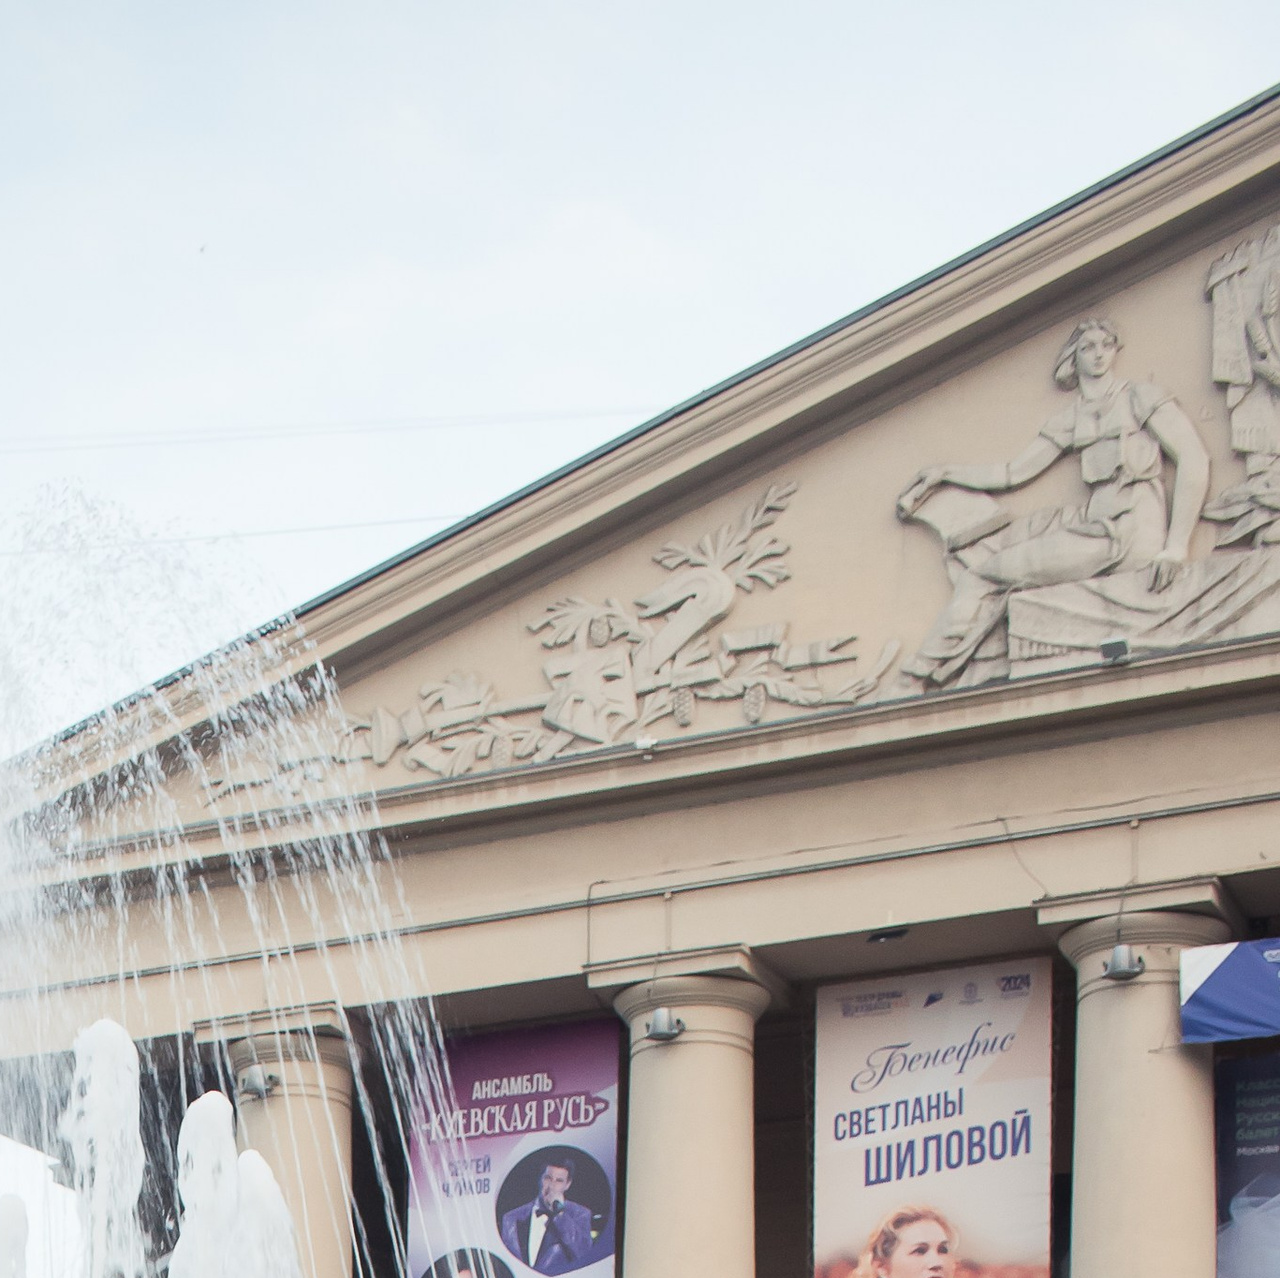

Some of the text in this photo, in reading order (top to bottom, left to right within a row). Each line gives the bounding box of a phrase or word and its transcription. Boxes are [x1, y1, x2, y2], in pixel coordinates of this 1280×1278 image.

[472, 1073, 553, 1100] АНСАМБЛЬ
[850, 1022, 1016, 1094] Бенефис
[834, 1087, 964, 1141] СВЕТЛАНЫ
[864, 1108, 1032, 1187] ШИЛОВОЙ
